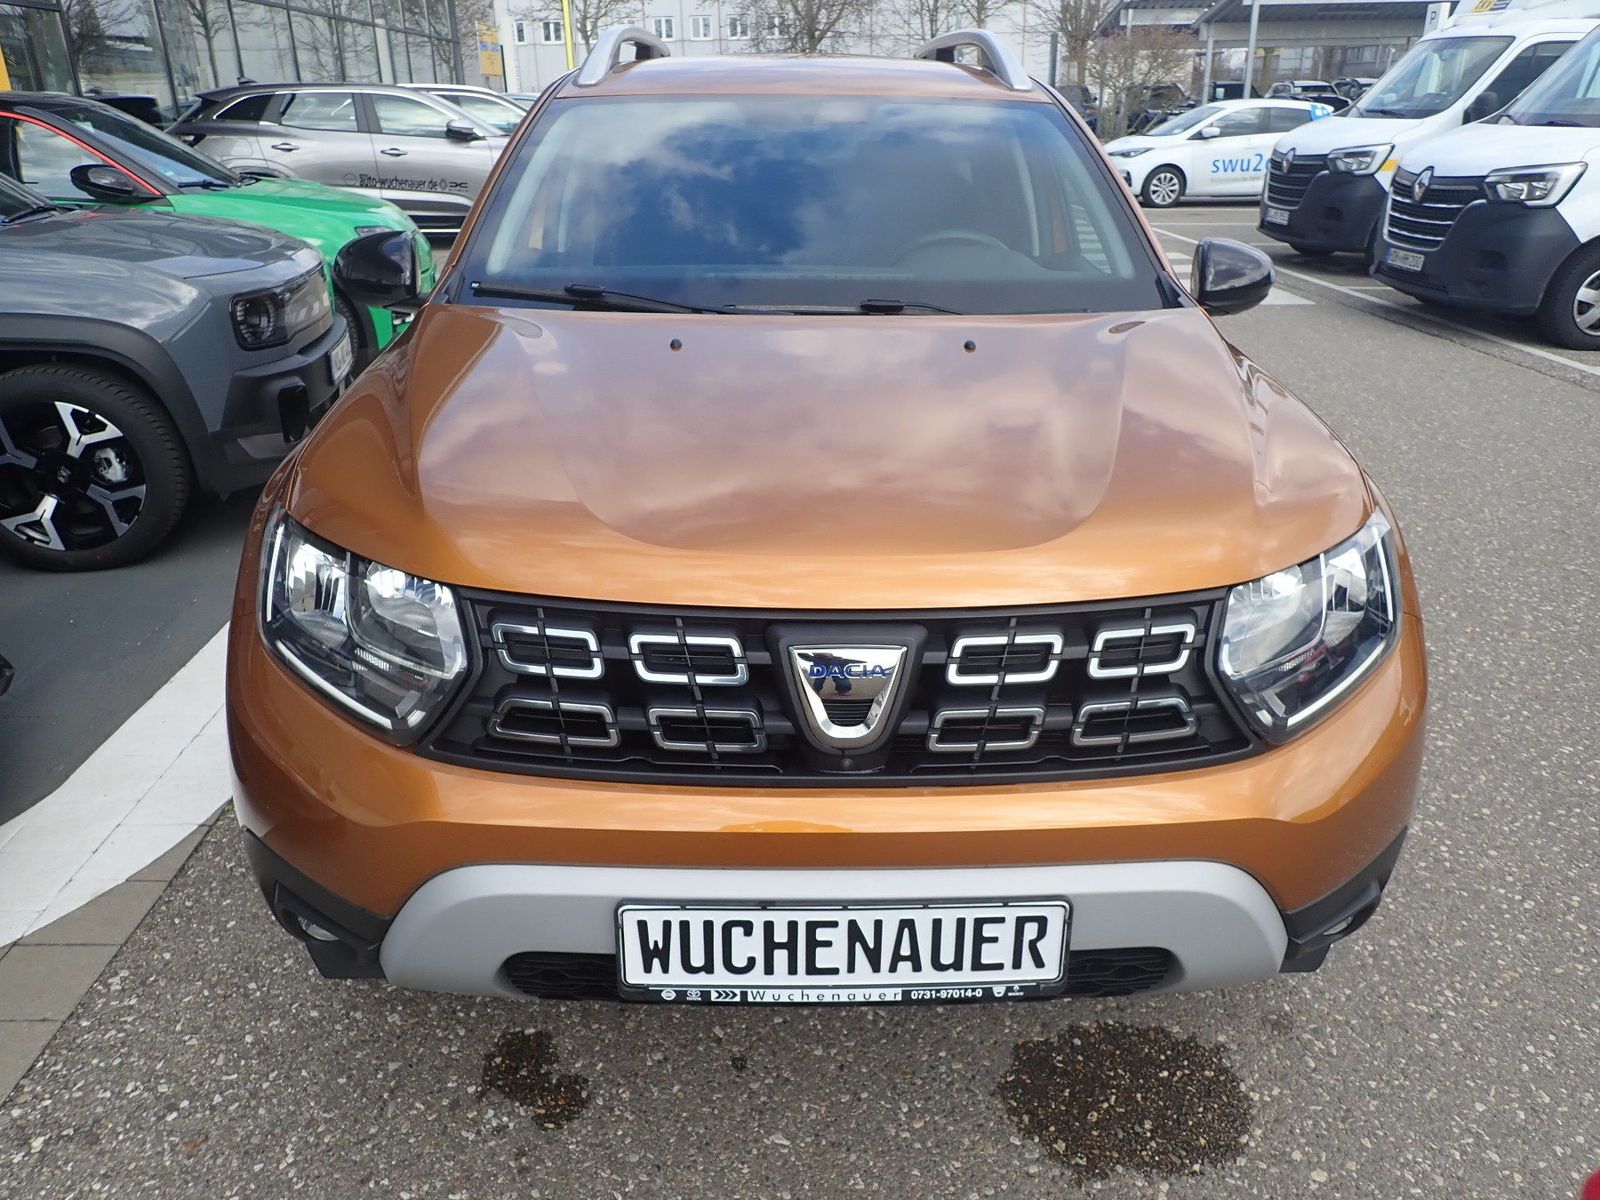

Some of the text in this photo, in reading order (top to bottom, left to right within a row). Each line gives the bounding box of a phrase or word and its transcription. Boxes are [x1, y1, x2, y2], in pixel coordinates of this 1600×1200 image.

[809, 664, 887, 679] DACIA
[637, 915, 1048, 975] WUCHENAUER
[750, 988, 983, 1002] Wuchenauer 0731-97014-0
